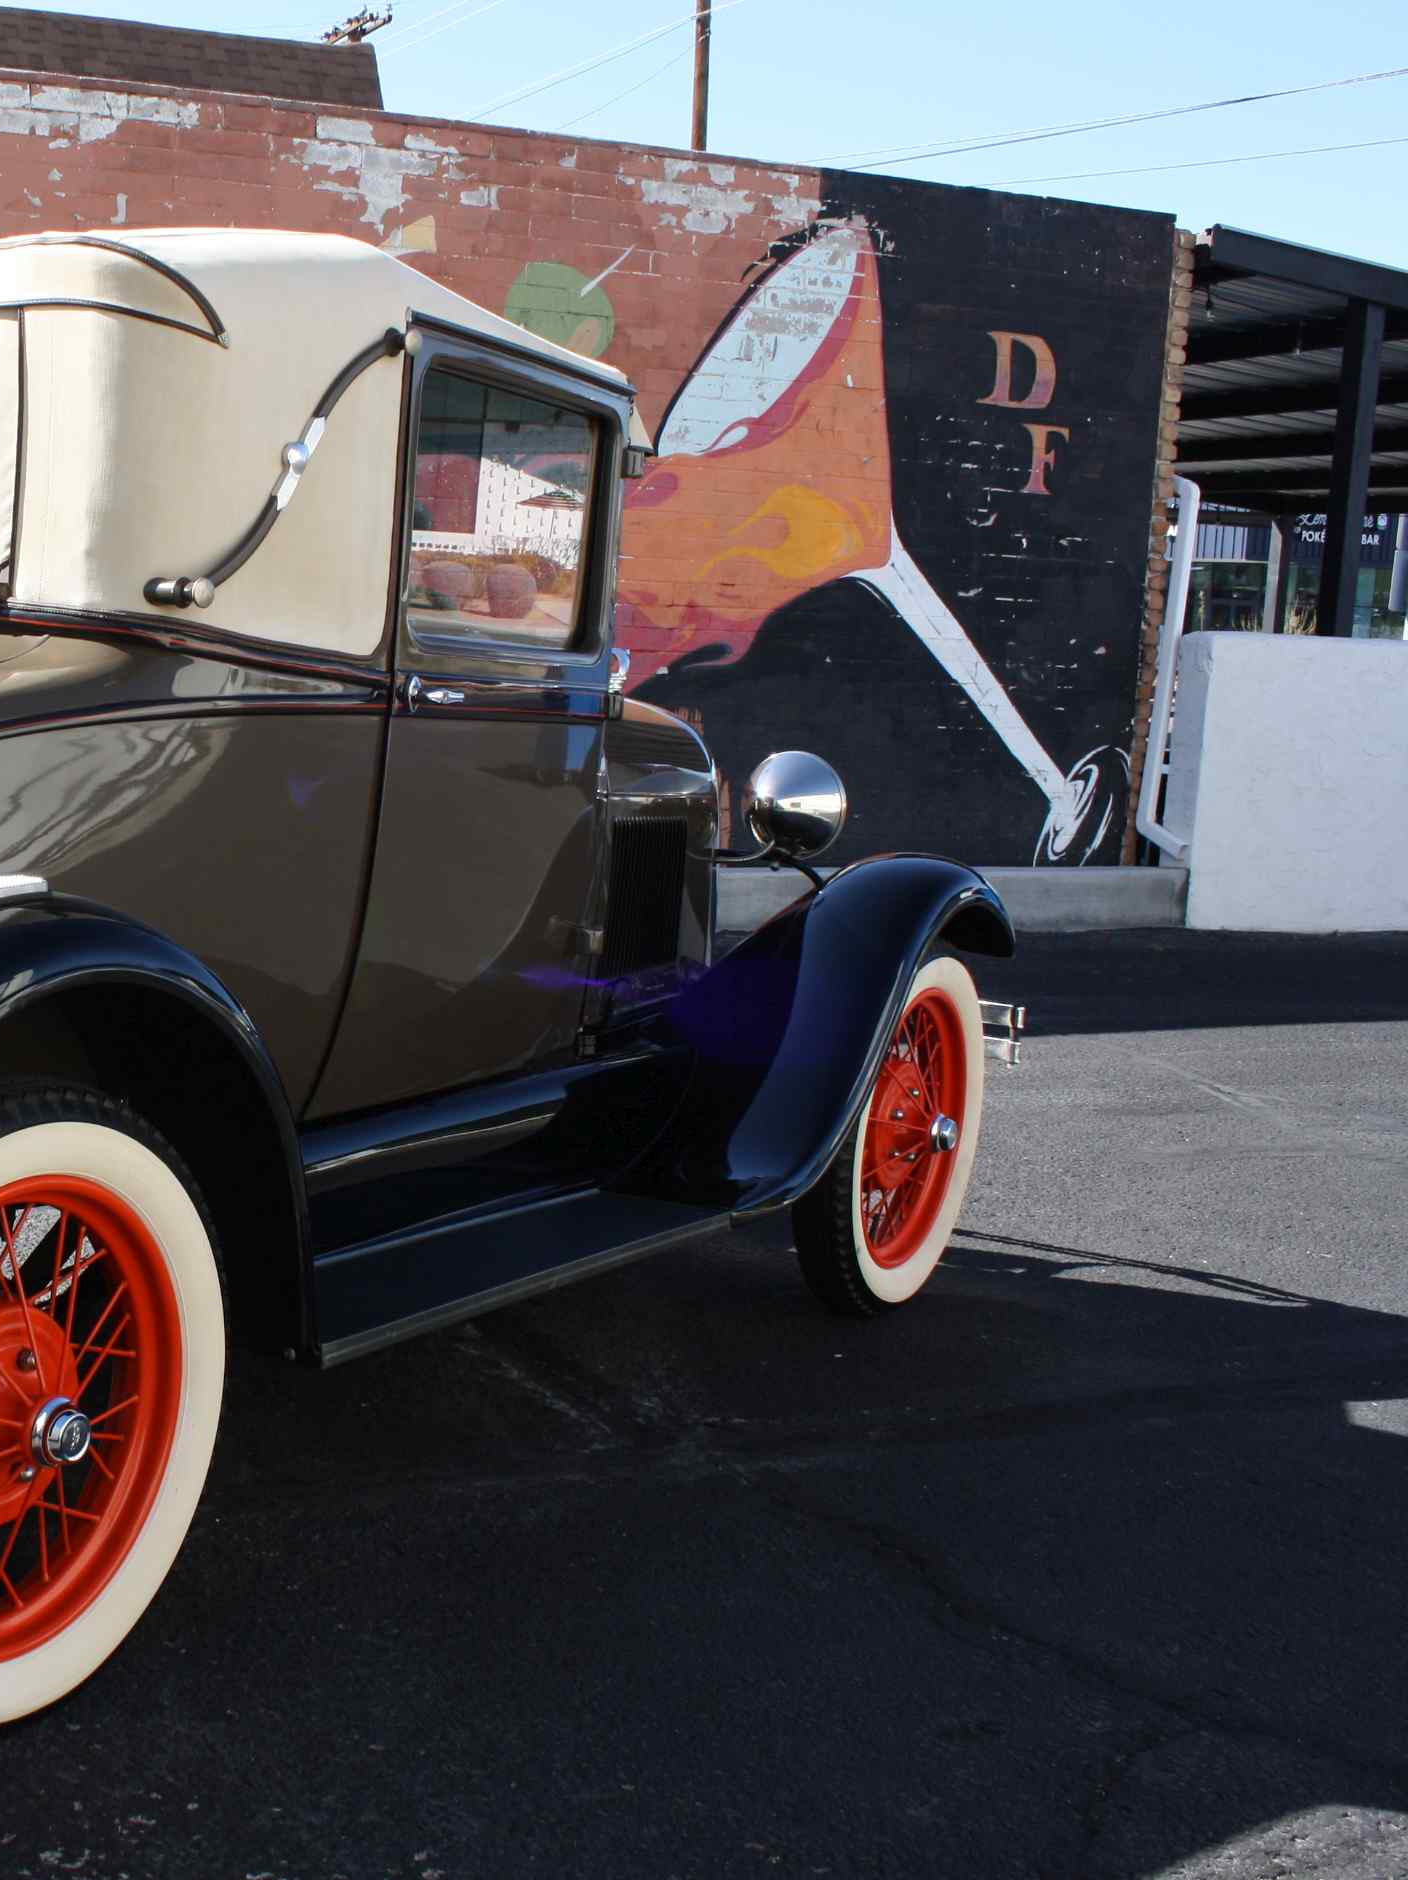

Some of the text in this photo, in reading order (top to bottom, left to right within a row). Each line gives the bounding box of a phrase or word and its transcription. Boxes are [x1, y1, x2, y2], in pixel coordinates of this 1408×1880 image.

[976, 331, 1056, 409] D
[1022, 424, 1070, 496] F
[1361, 534, 1380, 545] BAR
